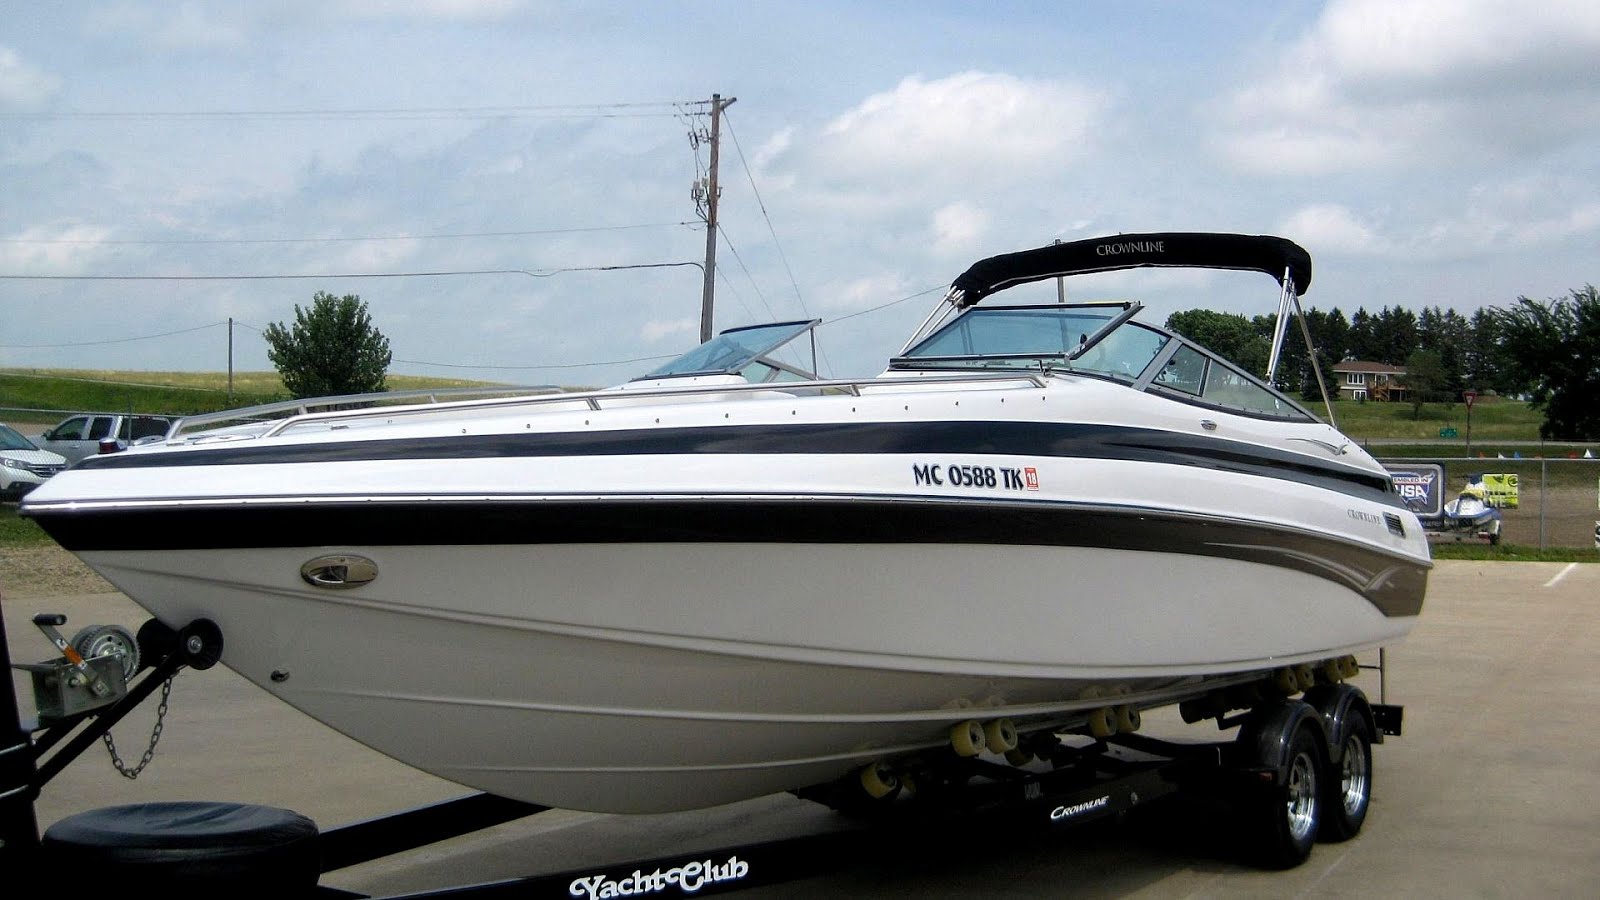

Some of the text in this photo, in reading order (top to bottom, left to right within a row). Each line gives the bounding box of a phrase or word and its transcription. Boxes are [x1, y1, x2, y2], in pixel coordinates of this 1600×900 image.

[1096, 241, 1165, 256] CROWNLINE
[912, 463, 1024, 490] MC 0588 TK
